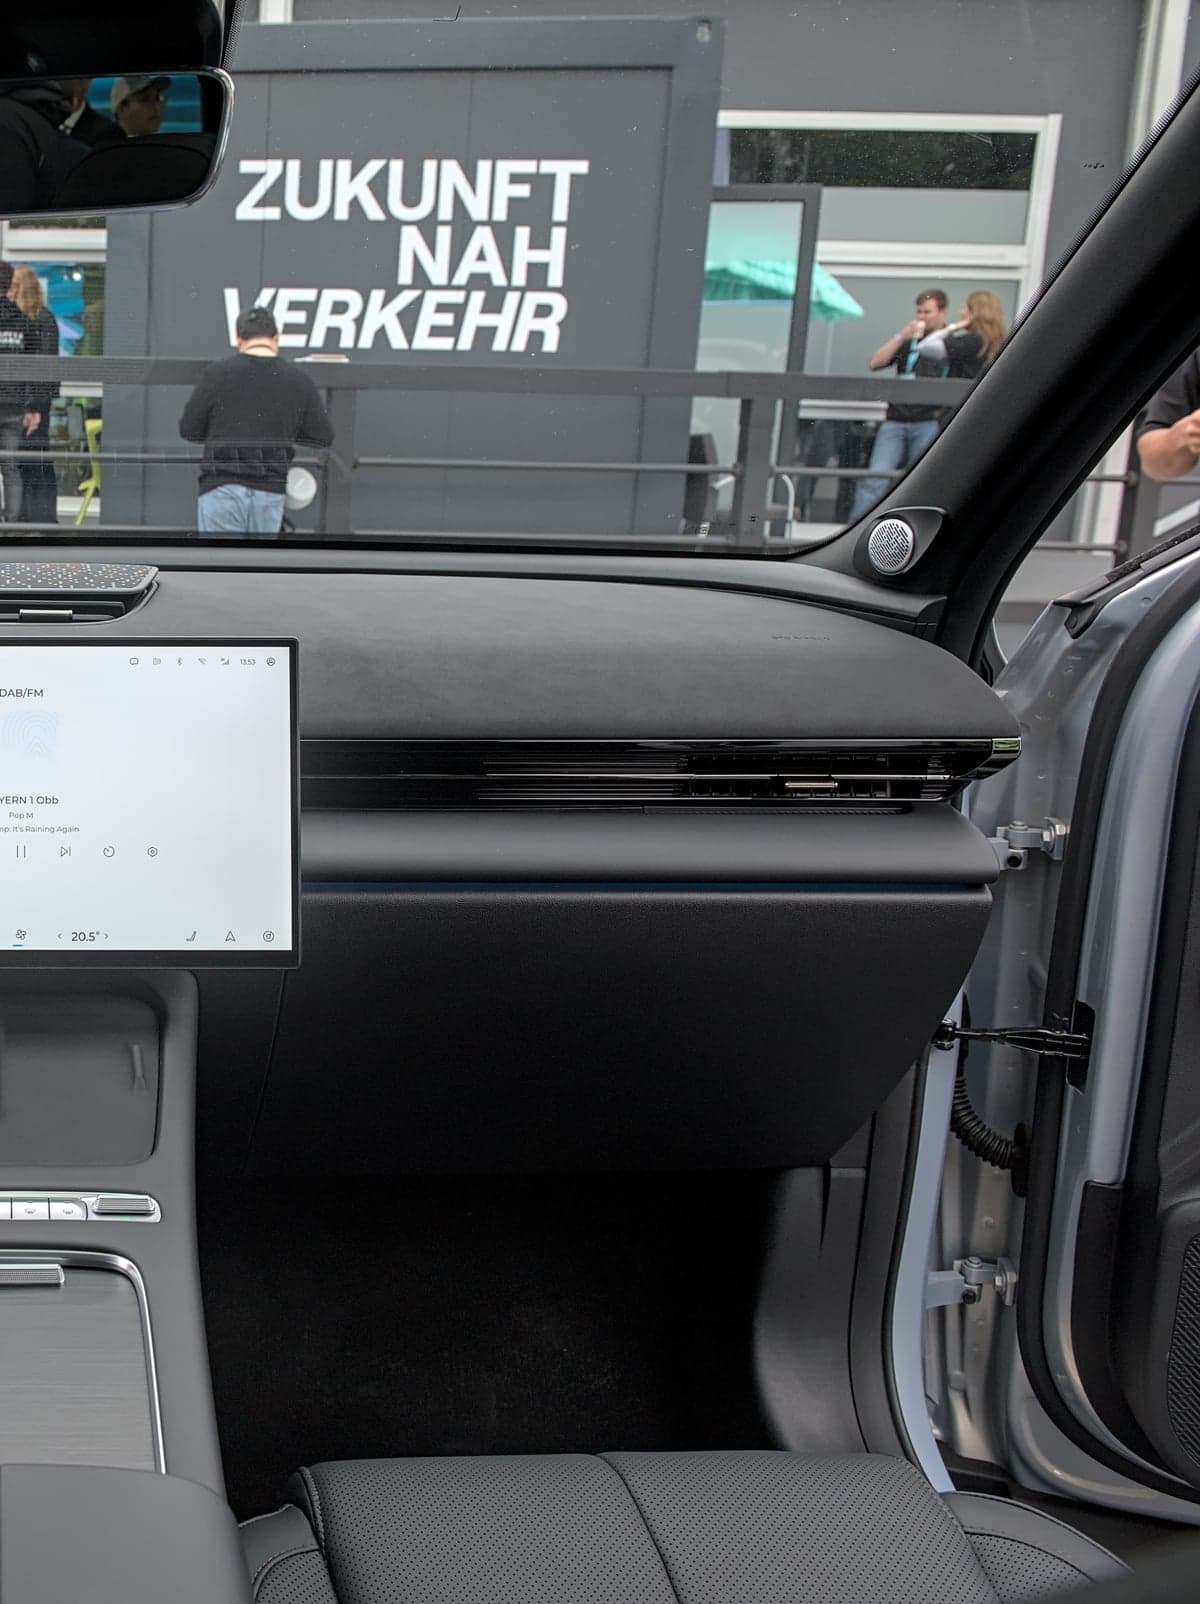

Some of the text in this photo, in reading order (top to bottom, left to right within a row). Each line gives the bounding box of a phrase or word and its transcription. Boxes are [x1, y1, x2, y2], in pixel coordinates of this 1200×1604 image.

[235, 159, 589, 222] ZUKUNFT
[397, 225, 567, 287] NAH
[224, 288, 567, 353] VERKEHR
[0, 687, 44, 699] DAB/FM
[36, 795, 60, 805] Obb
[8, 811, 25, 820] Pop
[12, 825, 24, 833] It's
[25, 825, 55, 835] Raining
[56, 825, 80, 835] Again
